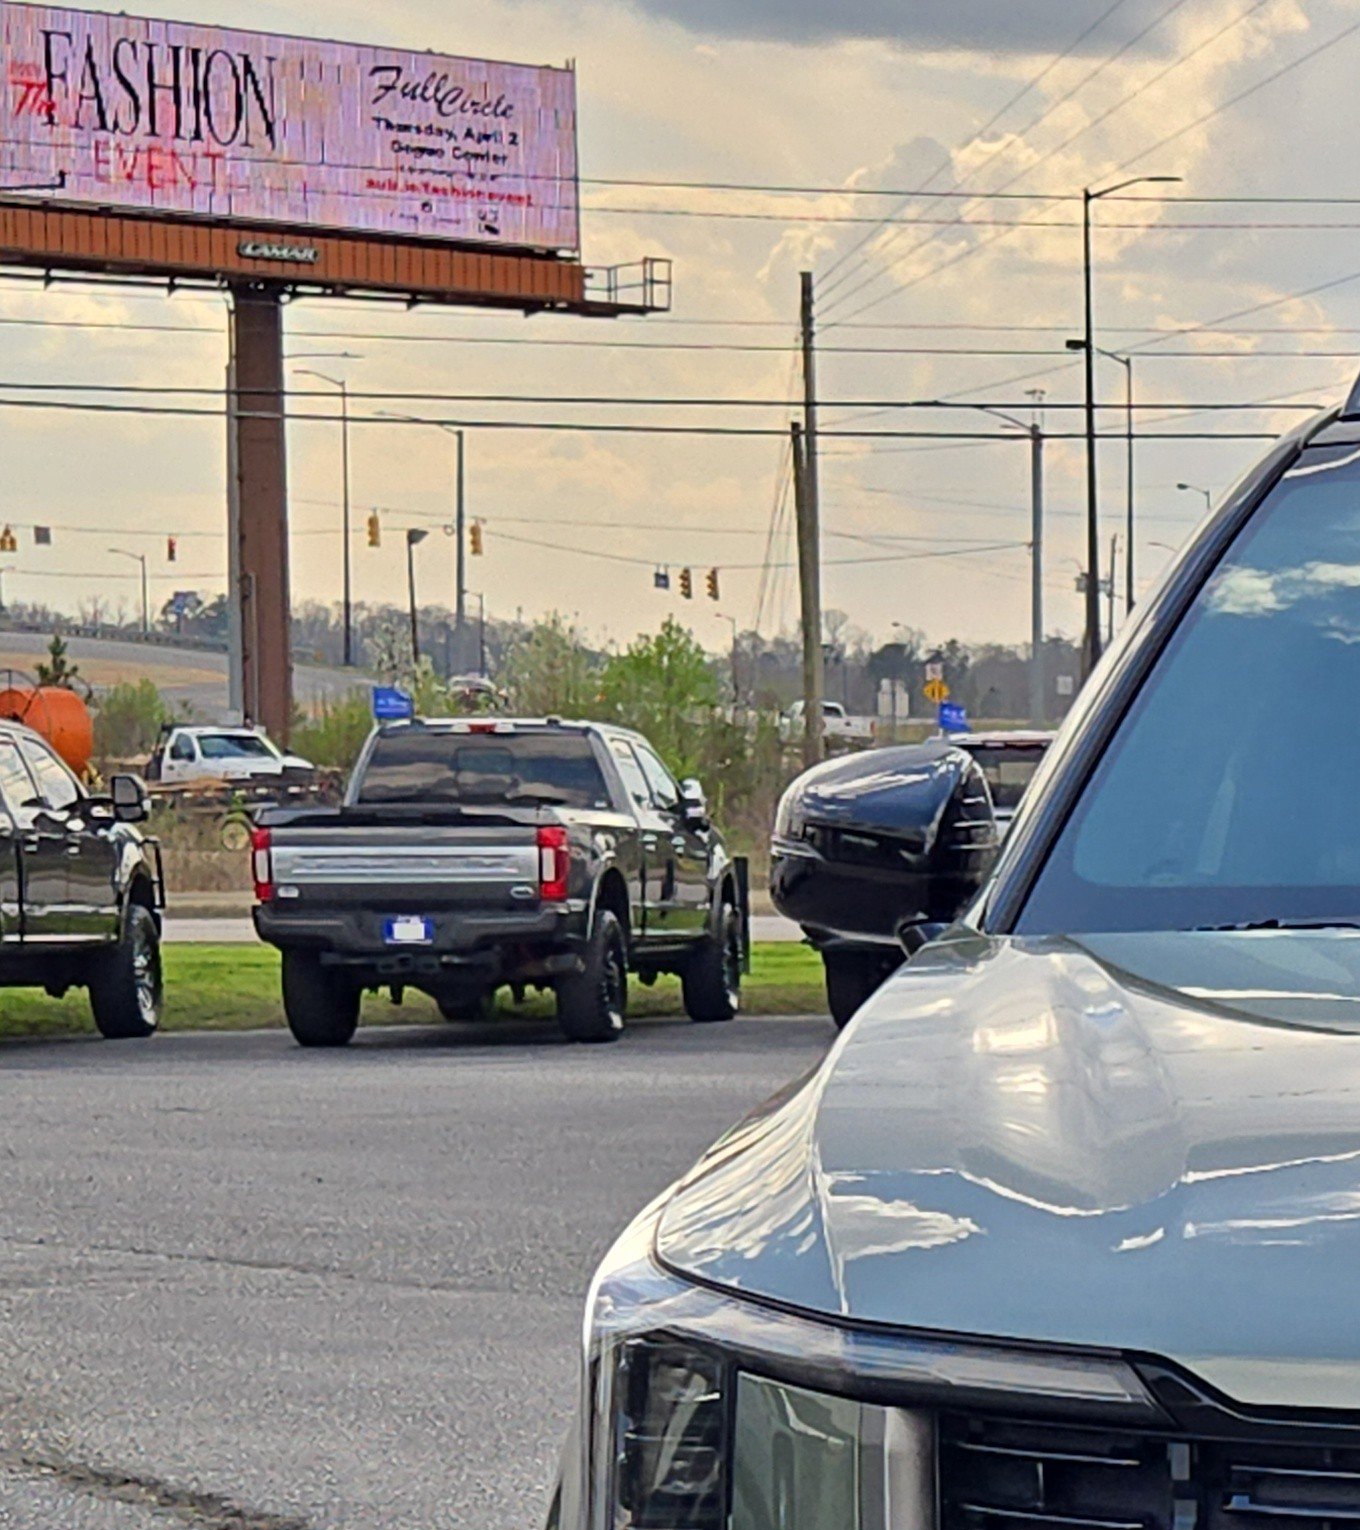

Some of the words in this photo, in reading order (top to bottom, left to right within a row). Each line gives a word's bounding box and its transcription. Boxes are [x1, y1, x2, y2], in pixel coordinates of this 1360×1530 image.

[40, 29, 278, 150] FASHION
[368, 65, 449, 105] Full
[508, 132, 519, 146] 2
[93, 139, 226, 193] EVENT
